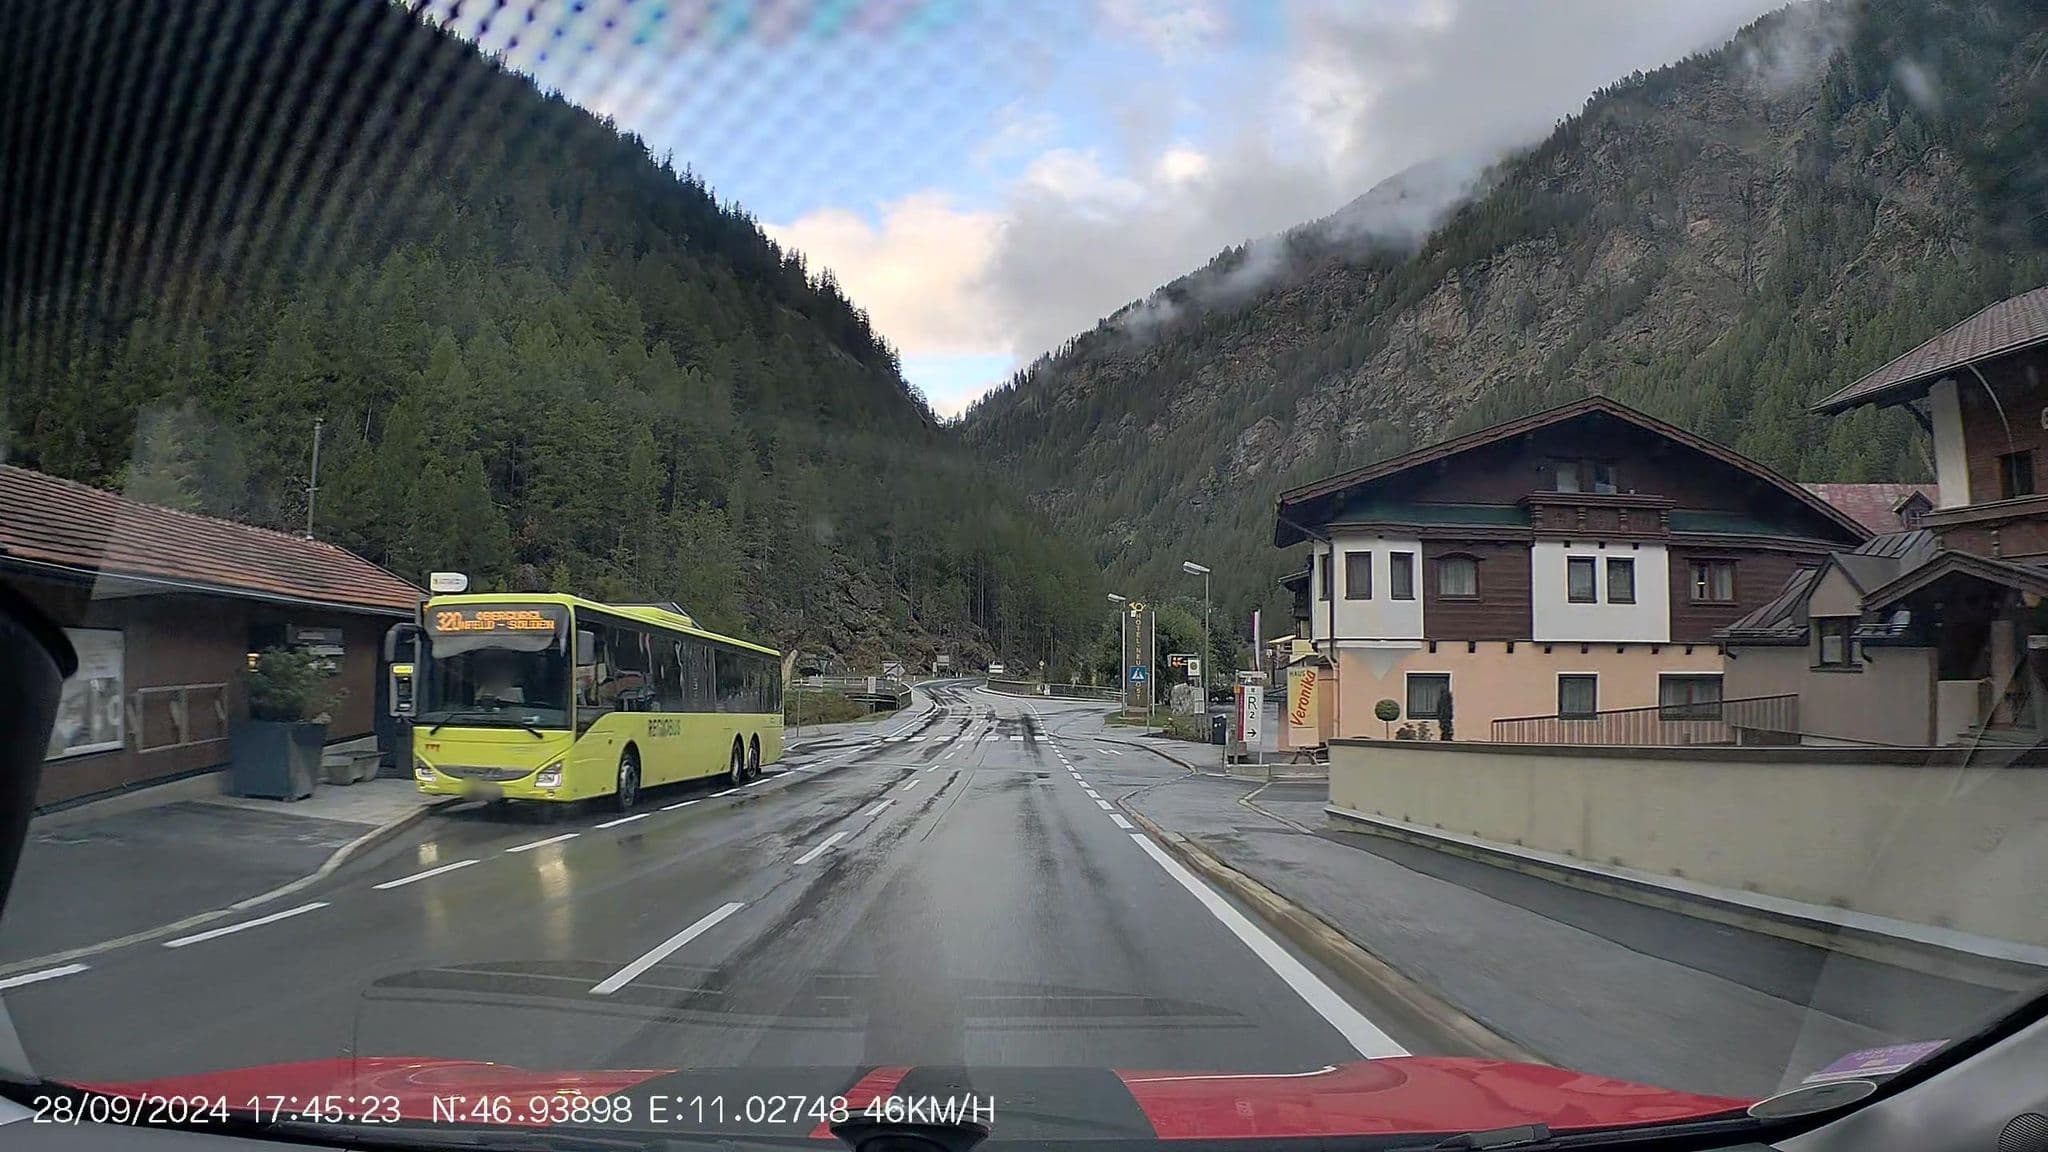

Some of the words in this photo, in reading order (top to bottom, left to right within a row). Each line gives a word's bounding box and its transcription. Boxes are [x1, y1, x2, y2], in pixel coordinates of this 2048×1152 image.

[436, 611, 462, 631] 320
[1247, 696, 1258, 710] R
[1289, 669, 1316, 726] Veronika
[1249, 711, 1255, 719] 2
